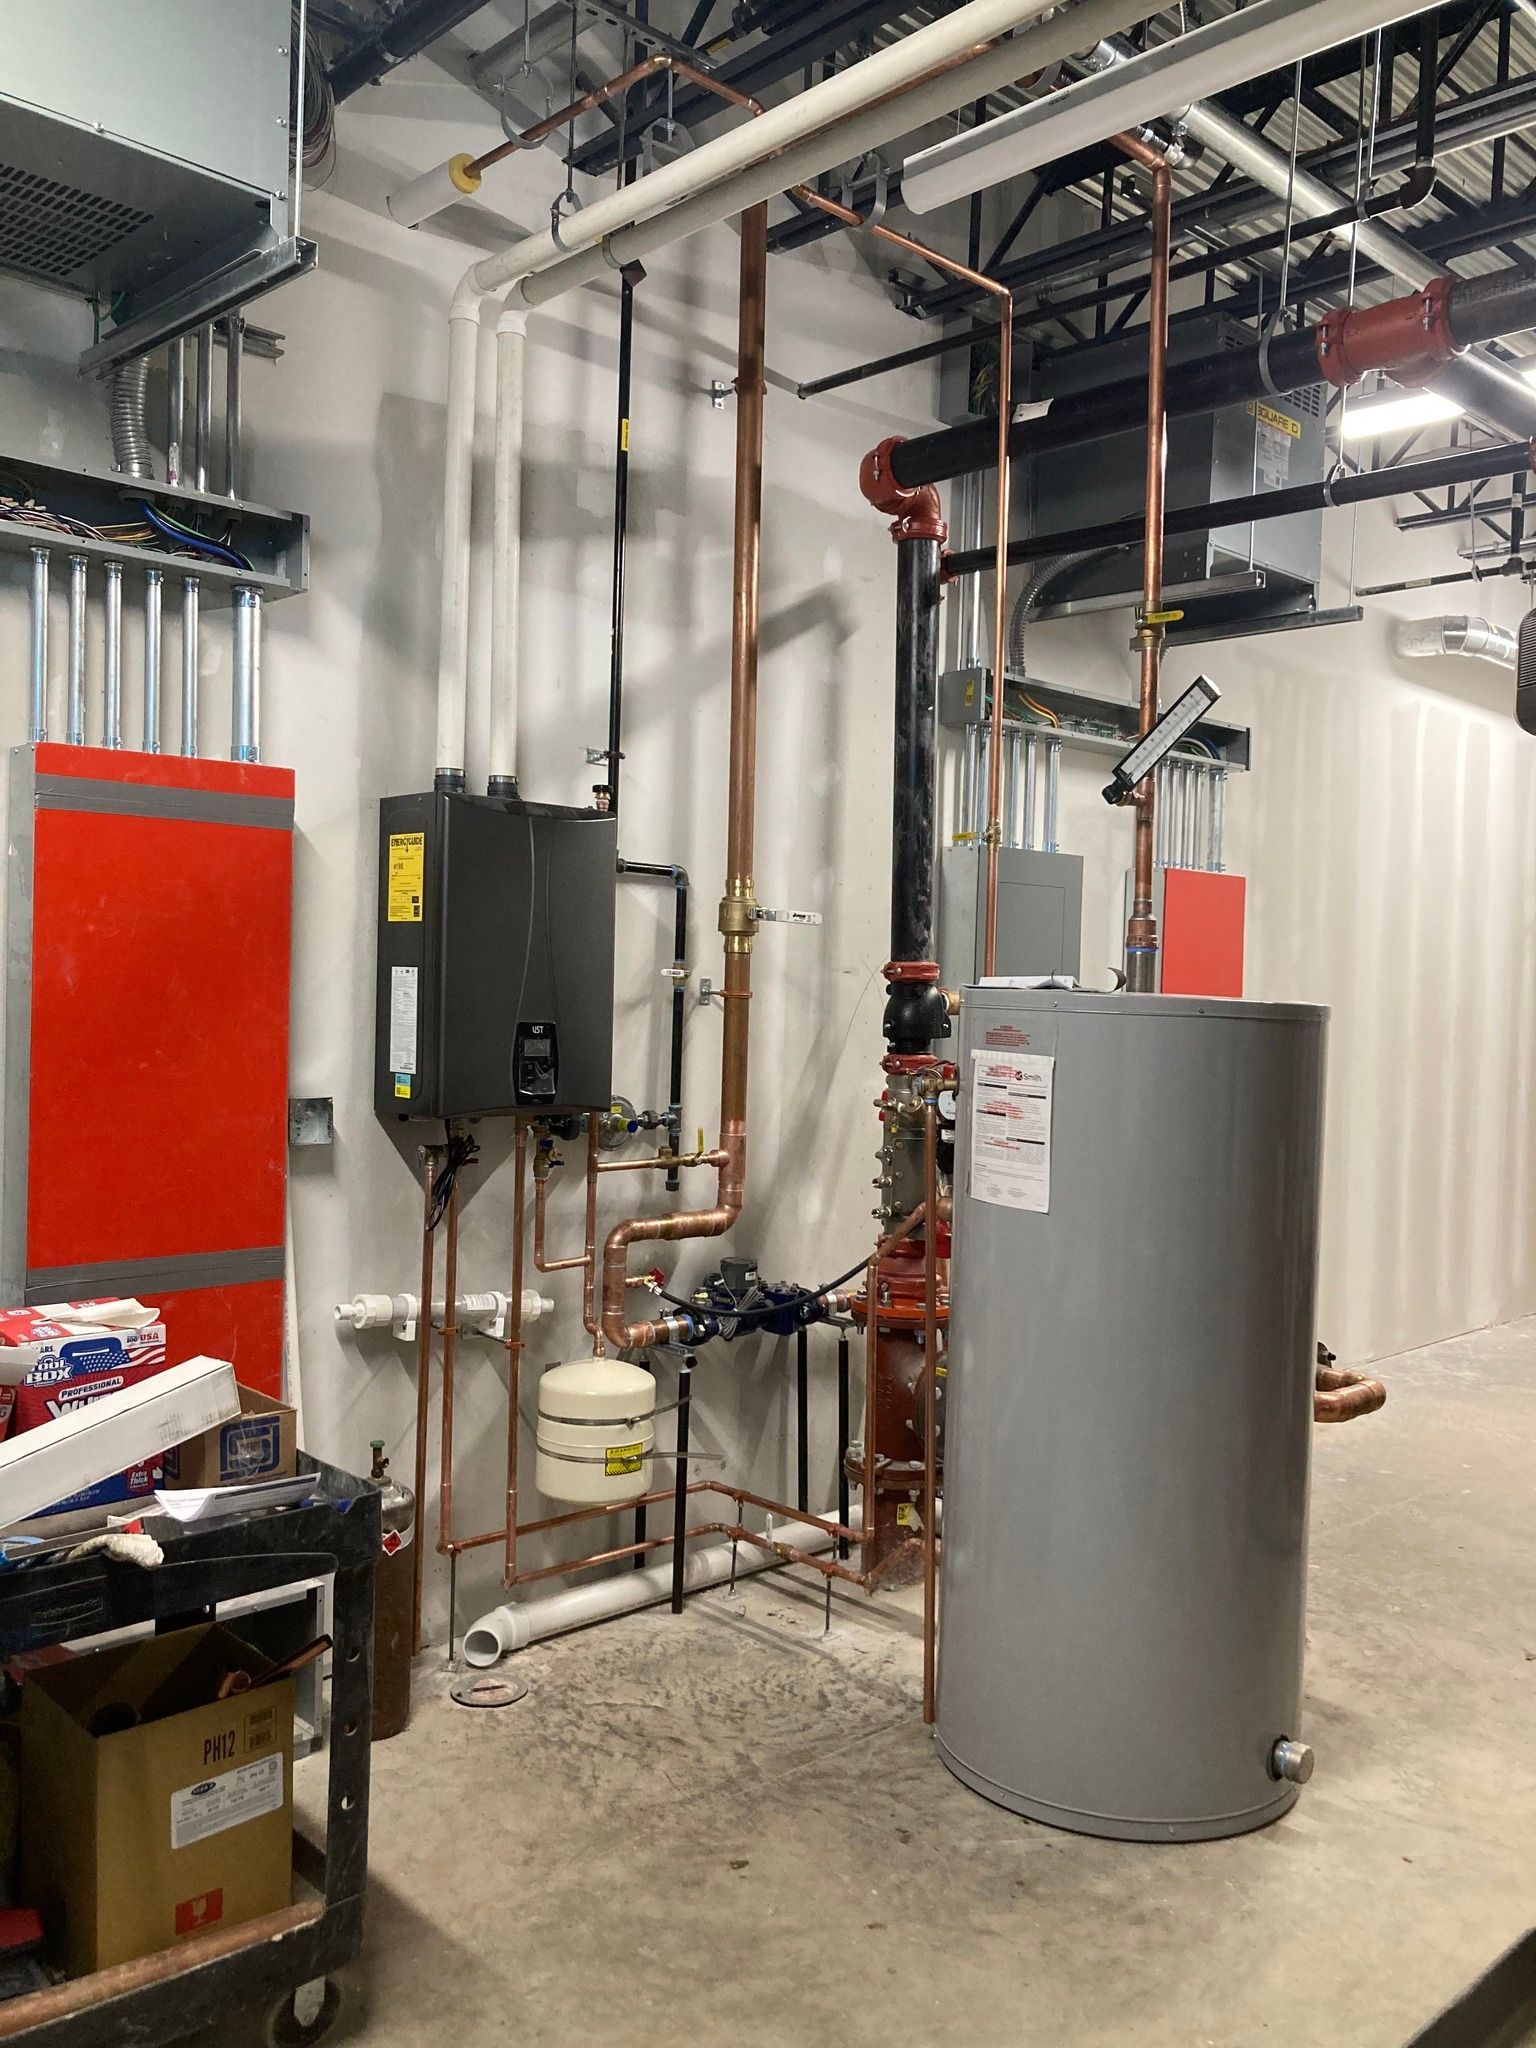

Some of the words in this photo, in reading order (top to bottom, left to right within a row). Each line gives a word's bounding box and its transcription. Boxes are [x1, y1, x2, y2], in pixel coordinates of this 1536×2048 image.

[140, 1333, 159, 1341] USA
[26, 1366, 71, 1384] BOX
[61, 1378, 121, 1398] PROFESSIONAL
[204, 1730, 235, 1765] PH12
